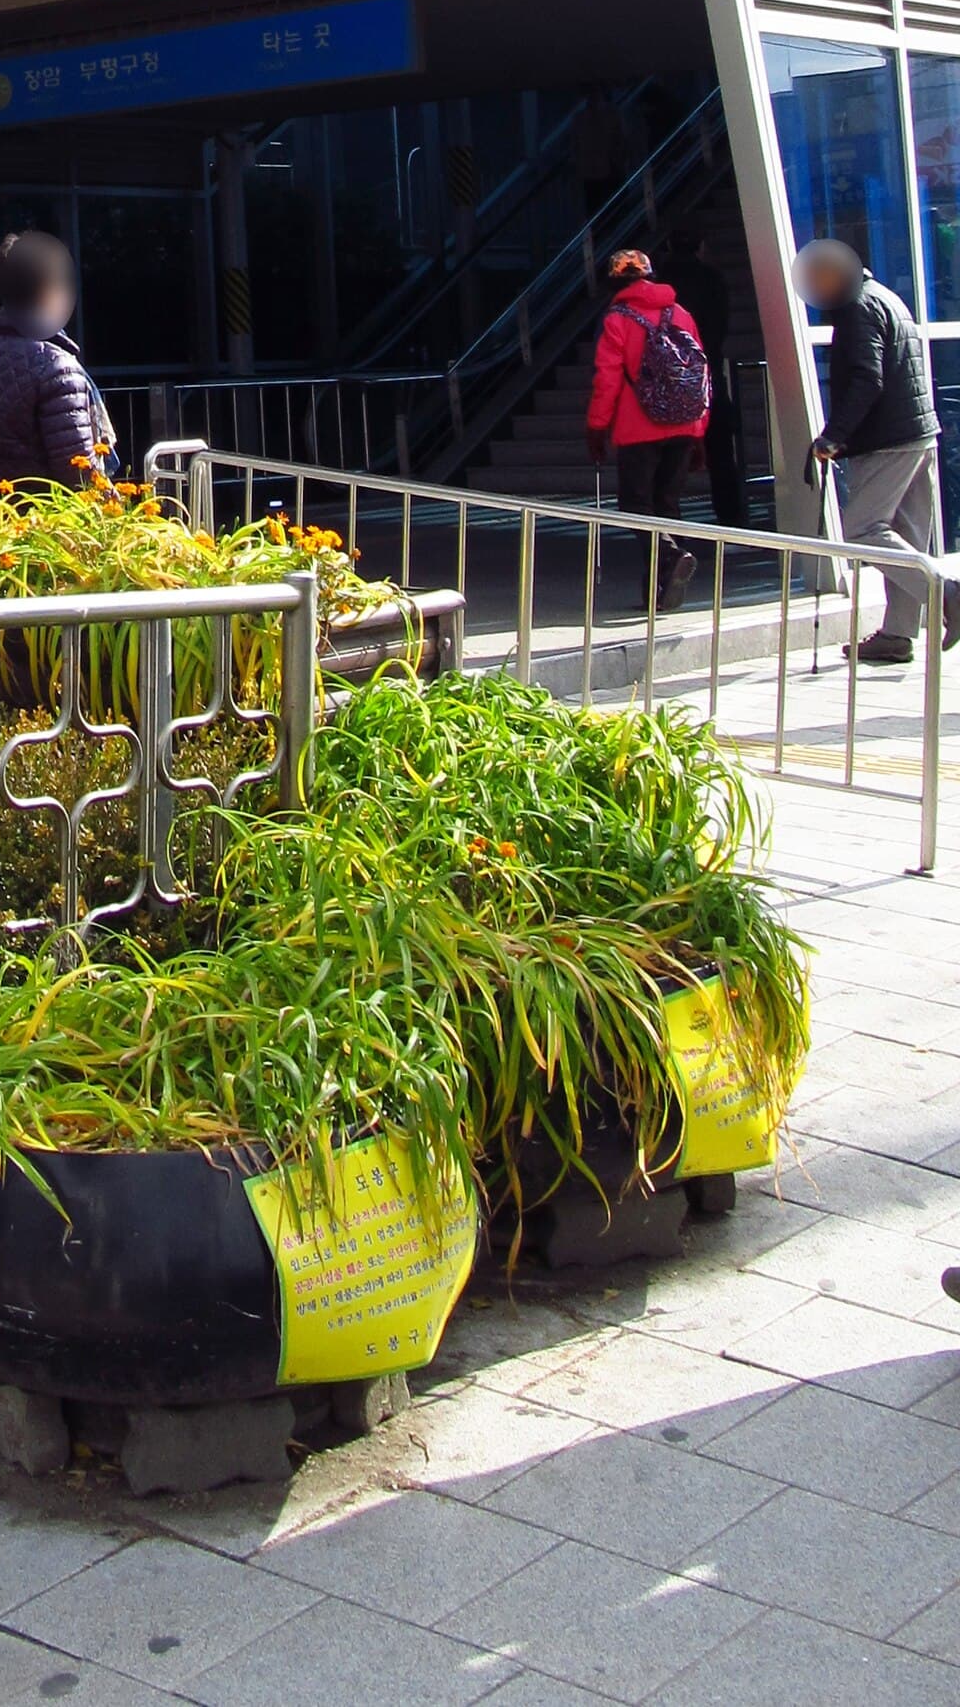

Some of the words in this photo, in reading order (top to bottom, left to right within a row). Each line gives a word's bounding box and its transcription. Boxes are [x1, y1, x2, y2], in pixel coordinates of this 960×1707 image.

[262, 29, 303, 54] 타는
[313, 22, 331, 50] 곳
[24, 66, 62, 91] 장암
[79, 50, 160, 82] 부평구청
